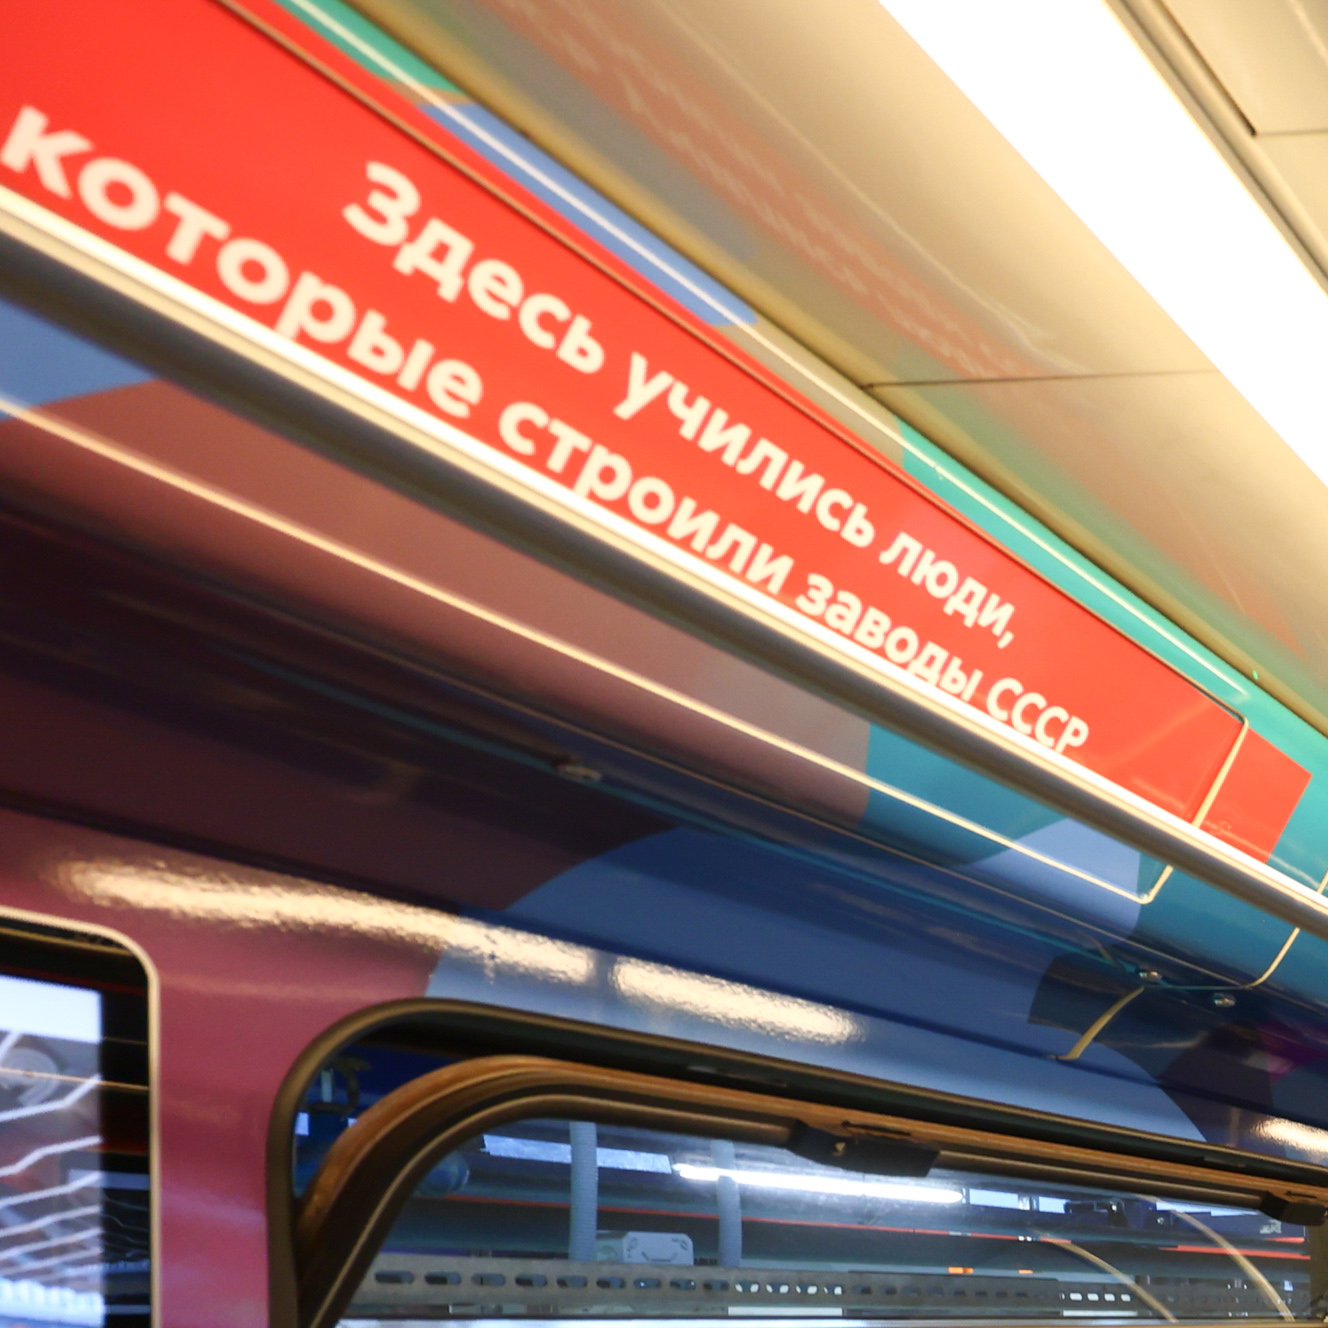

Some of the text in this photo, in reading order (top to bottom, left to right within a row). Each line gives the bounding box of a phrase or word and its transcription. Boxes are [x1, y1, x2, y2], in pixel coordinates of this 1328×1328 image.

[2, 106, 1092, 755] которые строили заводы СССР
[342, 161, 1017, 649] Здесь учились люди,
